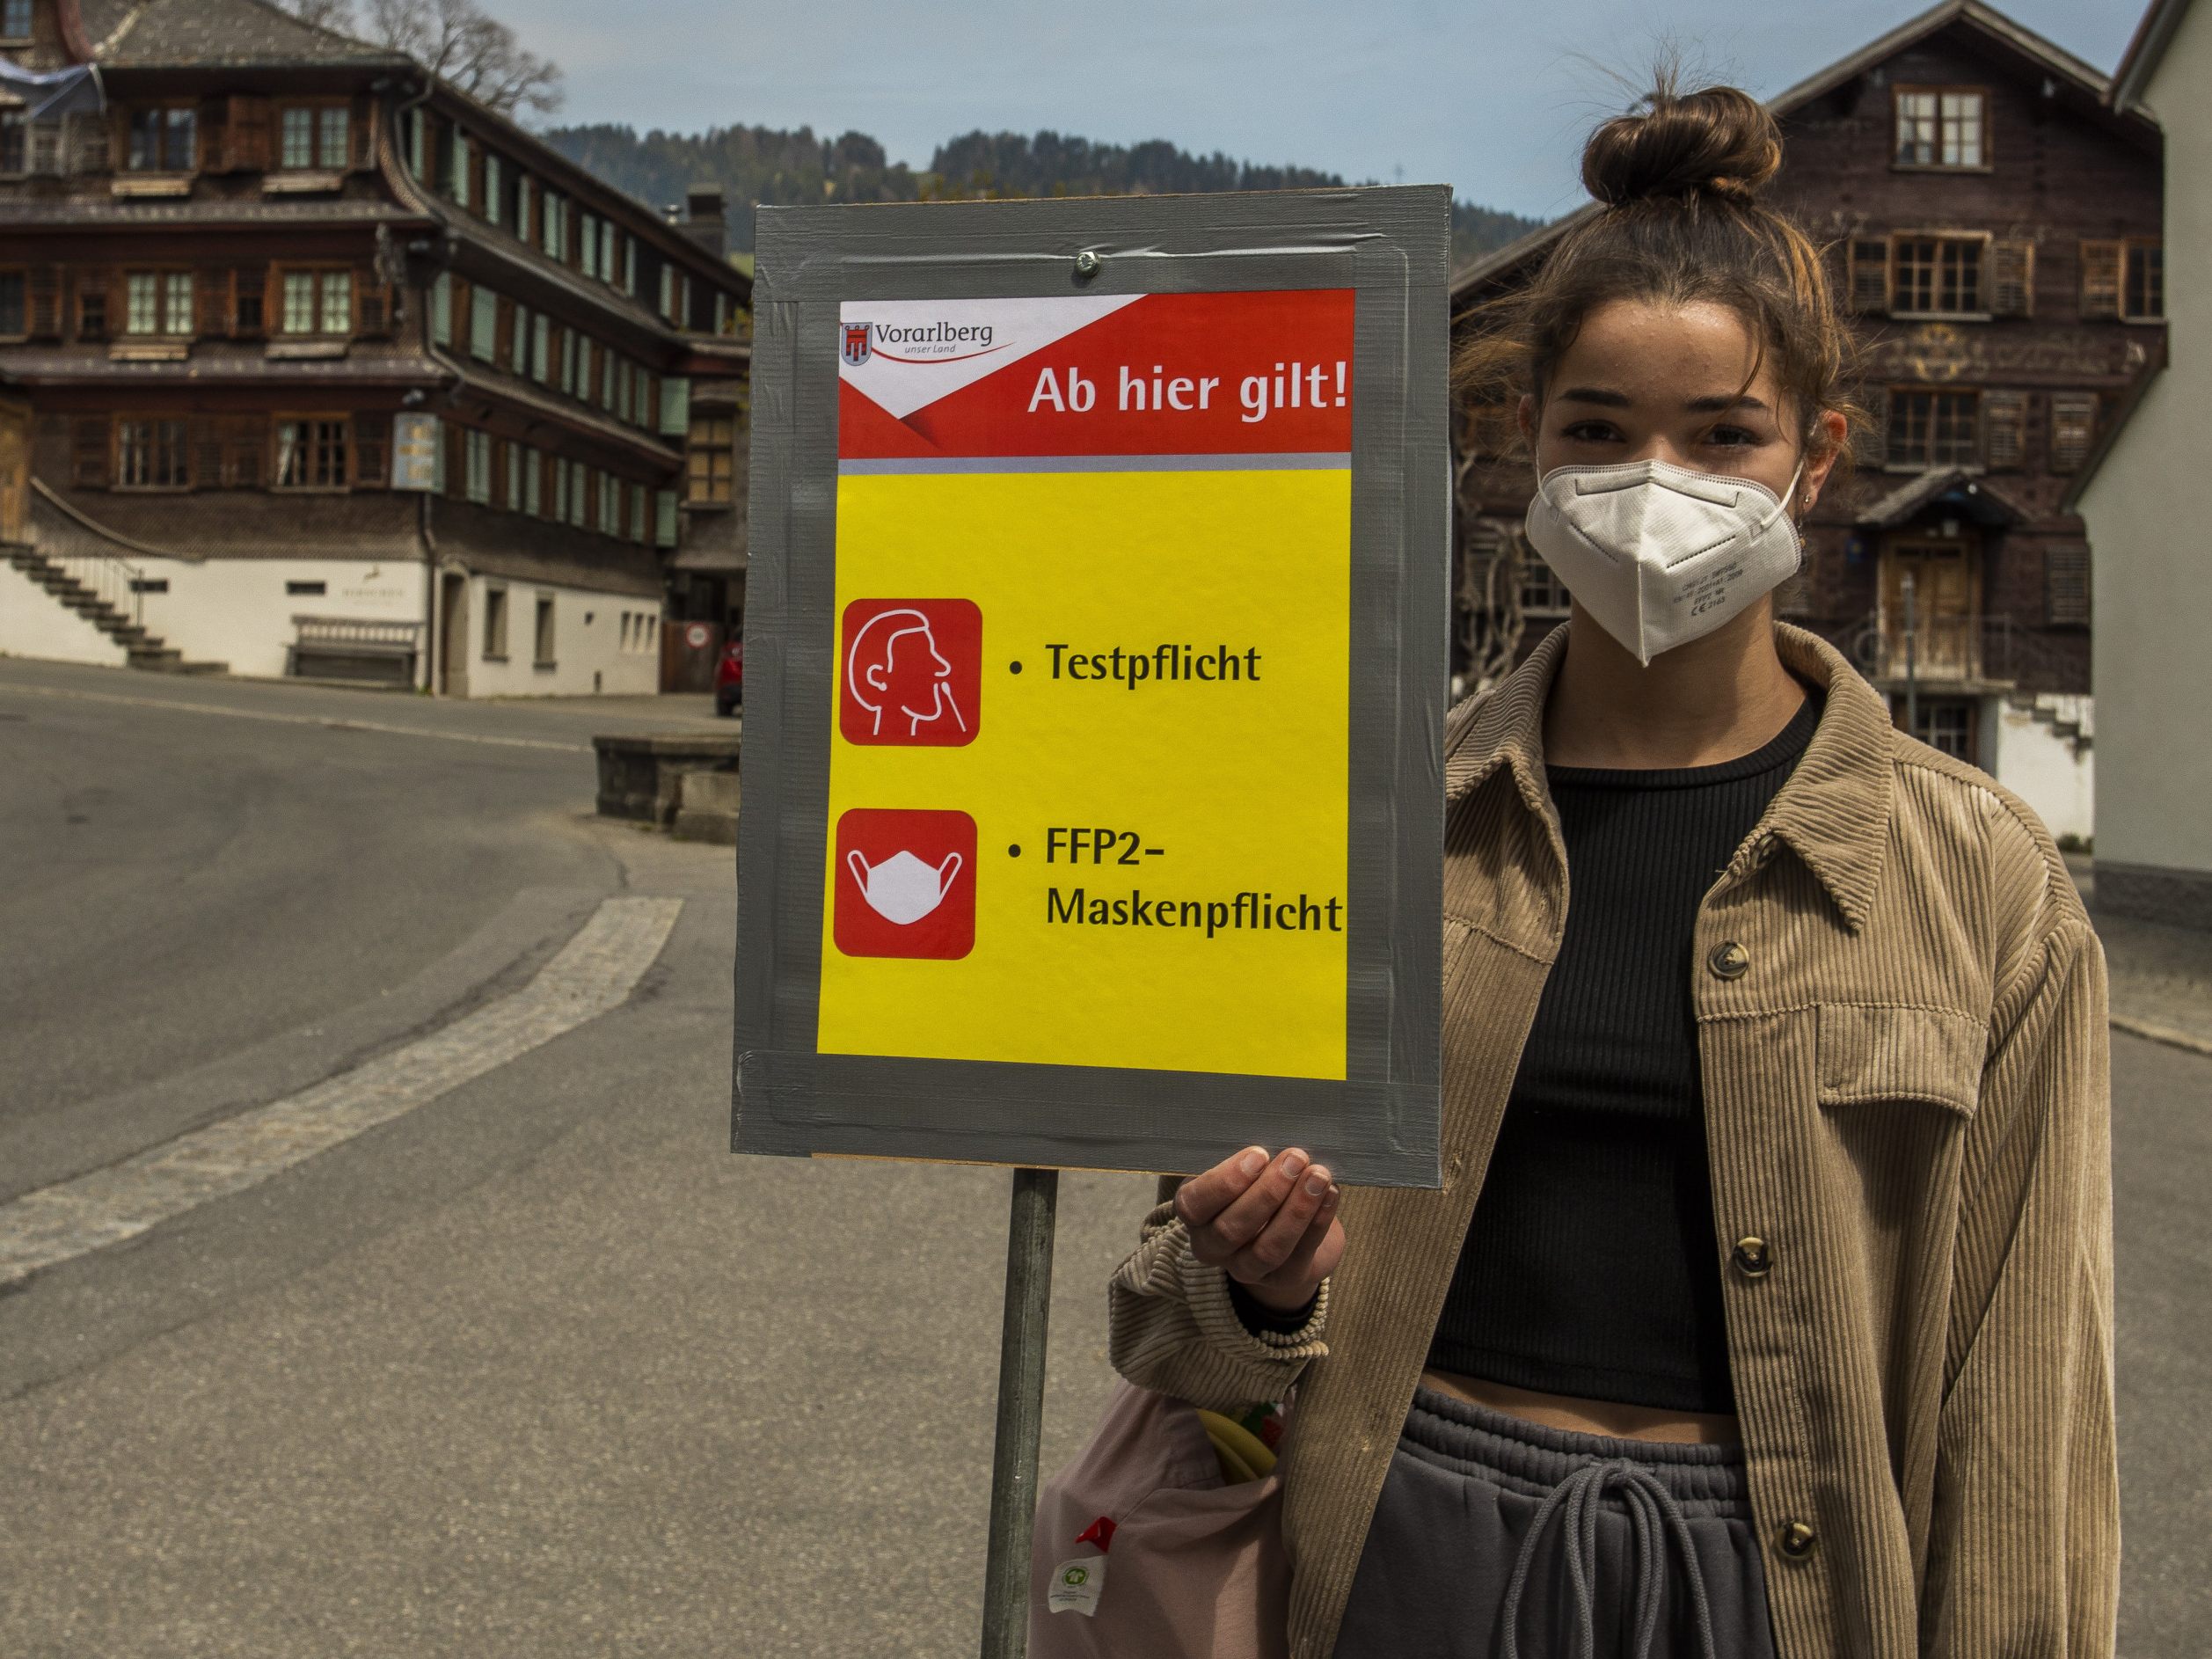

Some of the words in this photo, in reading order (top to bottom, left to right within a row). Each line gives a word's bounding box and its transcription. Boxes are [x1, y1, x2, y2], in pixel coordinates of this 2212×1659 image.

[875, 322, 992, 347] Vorarlberg
[905, 345, 931, 354] unser
[933, 344, 956, 353] Land
[1027, 367, 1096, 413] Ab
[1119, 365, 1218, 411] hier
[1240, 361, 1347, 423] gilt!
[1045, 644, 1262, 691] Testpflicht
[1047, 828, 1164, 865] FFP2-
[1047, 888, 1343, 939] Maskenpflicht
